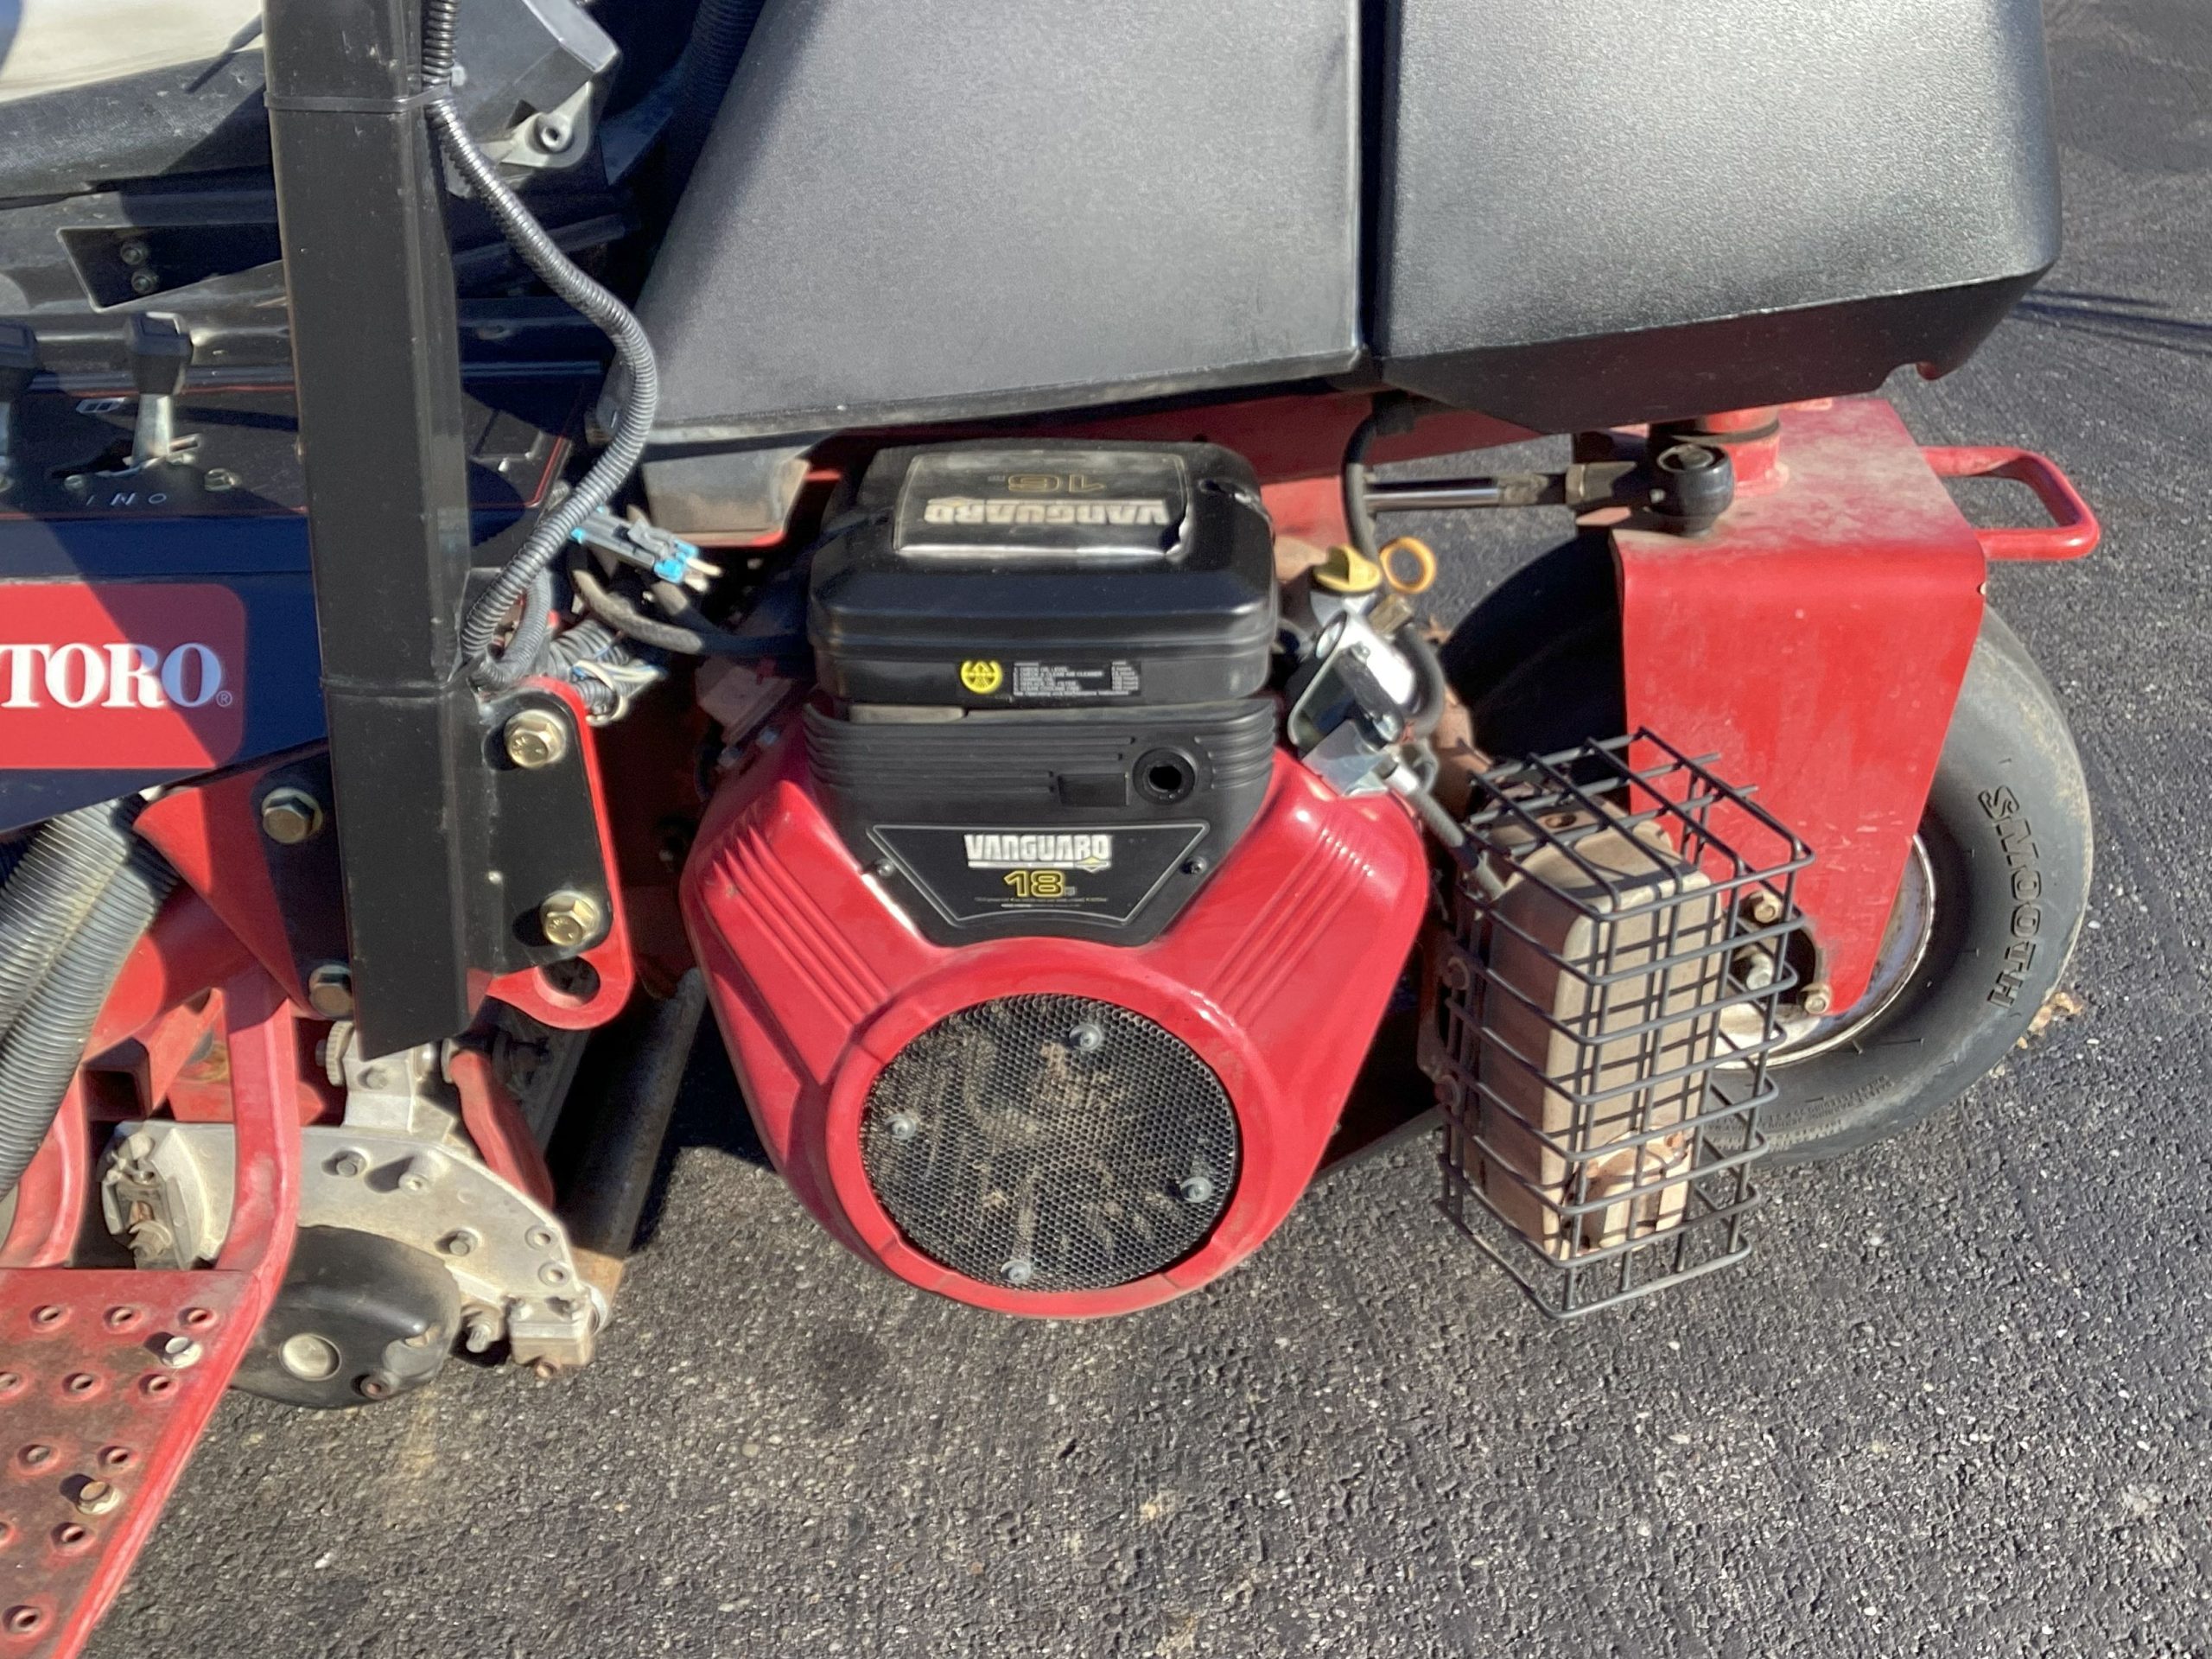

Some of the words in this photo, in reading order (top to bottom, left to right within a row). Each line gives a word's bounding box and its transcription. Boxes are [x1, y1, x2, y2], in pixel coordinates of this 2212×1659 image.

[923, 504, 1171, 526] VANGUARD
[0, 642, 222, 709] TORO
[963, 835, 1113, 861] VANGUARD
[1003, 870, 1065, 898] 18
[1978, 785, 2042, 1008] SMOOTH
